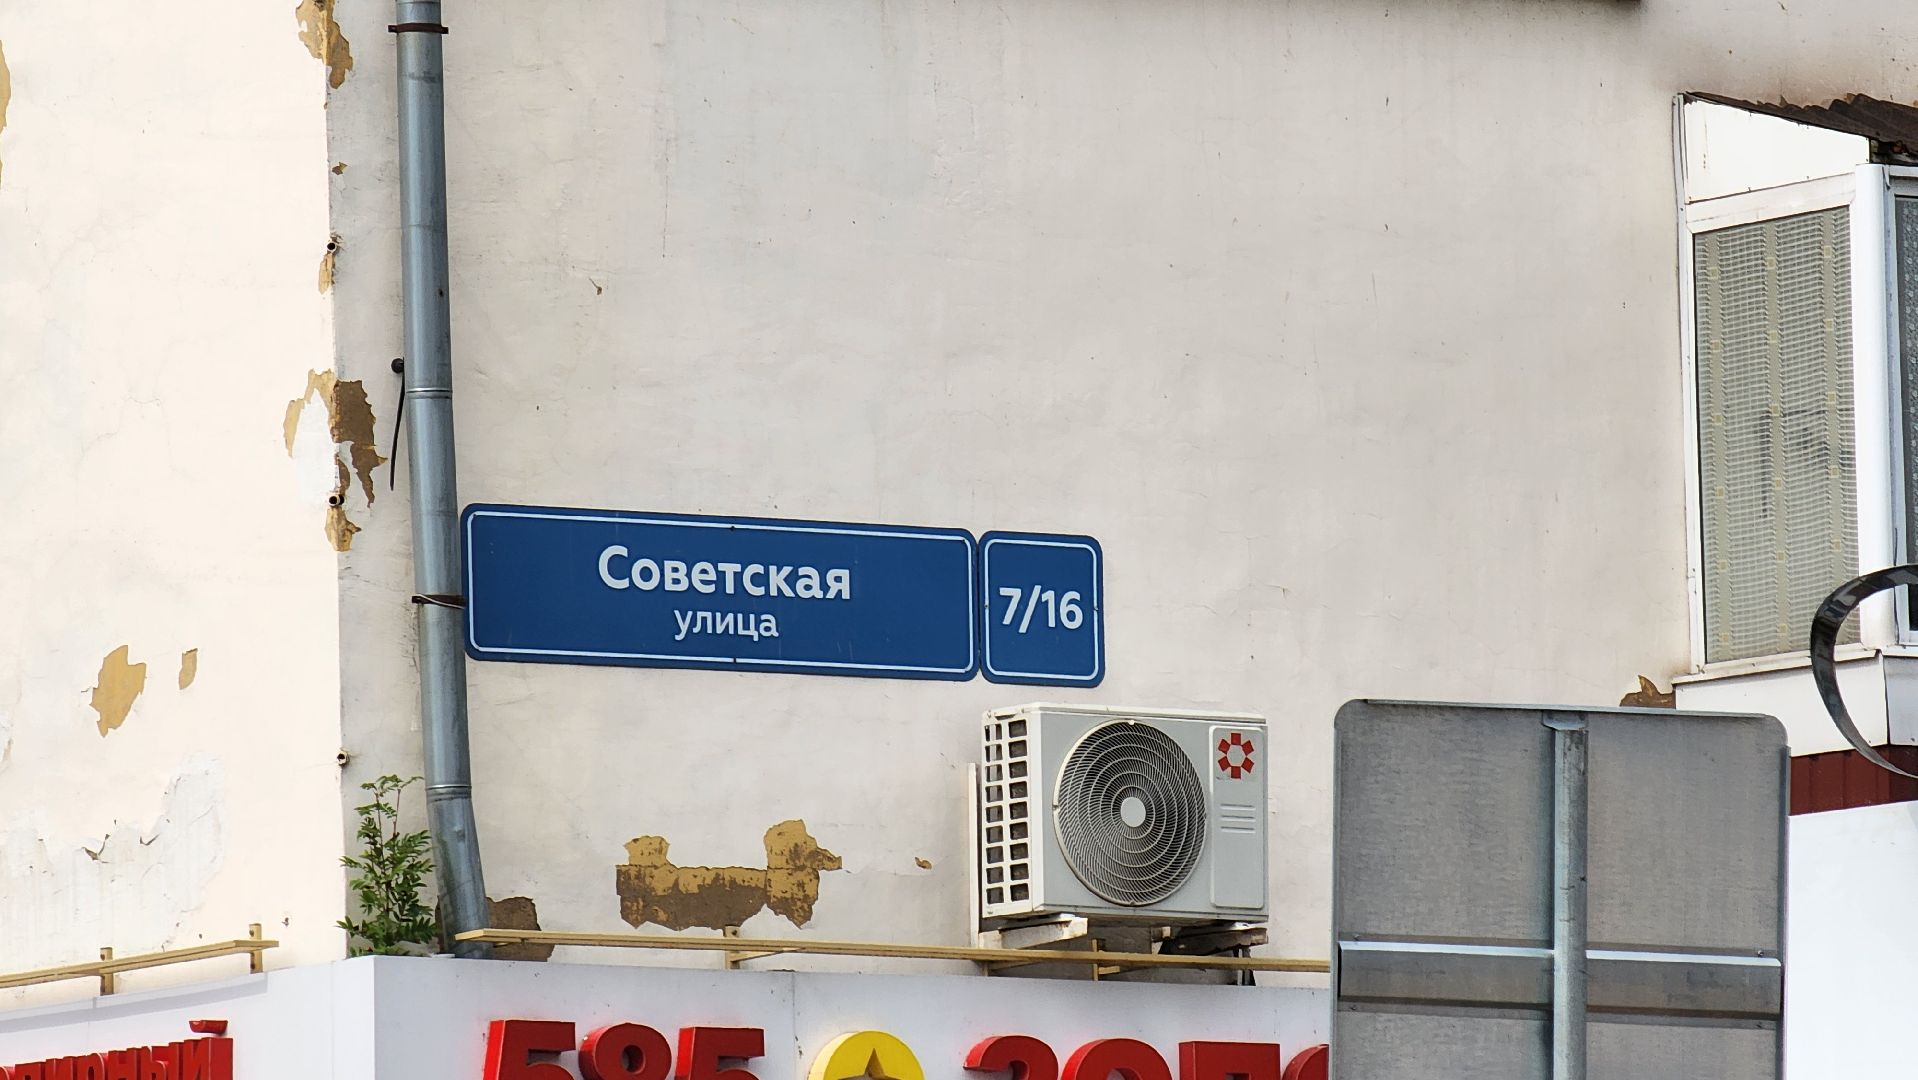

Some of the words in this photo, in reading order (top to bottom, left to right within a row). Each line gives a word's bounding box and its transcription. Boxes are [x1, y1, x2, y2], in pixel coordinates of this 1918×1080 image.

[598, 544, 851, 600] Советская
[673, 609, 780, 642] улица
[998, 584, 1085, 634] 7/16
